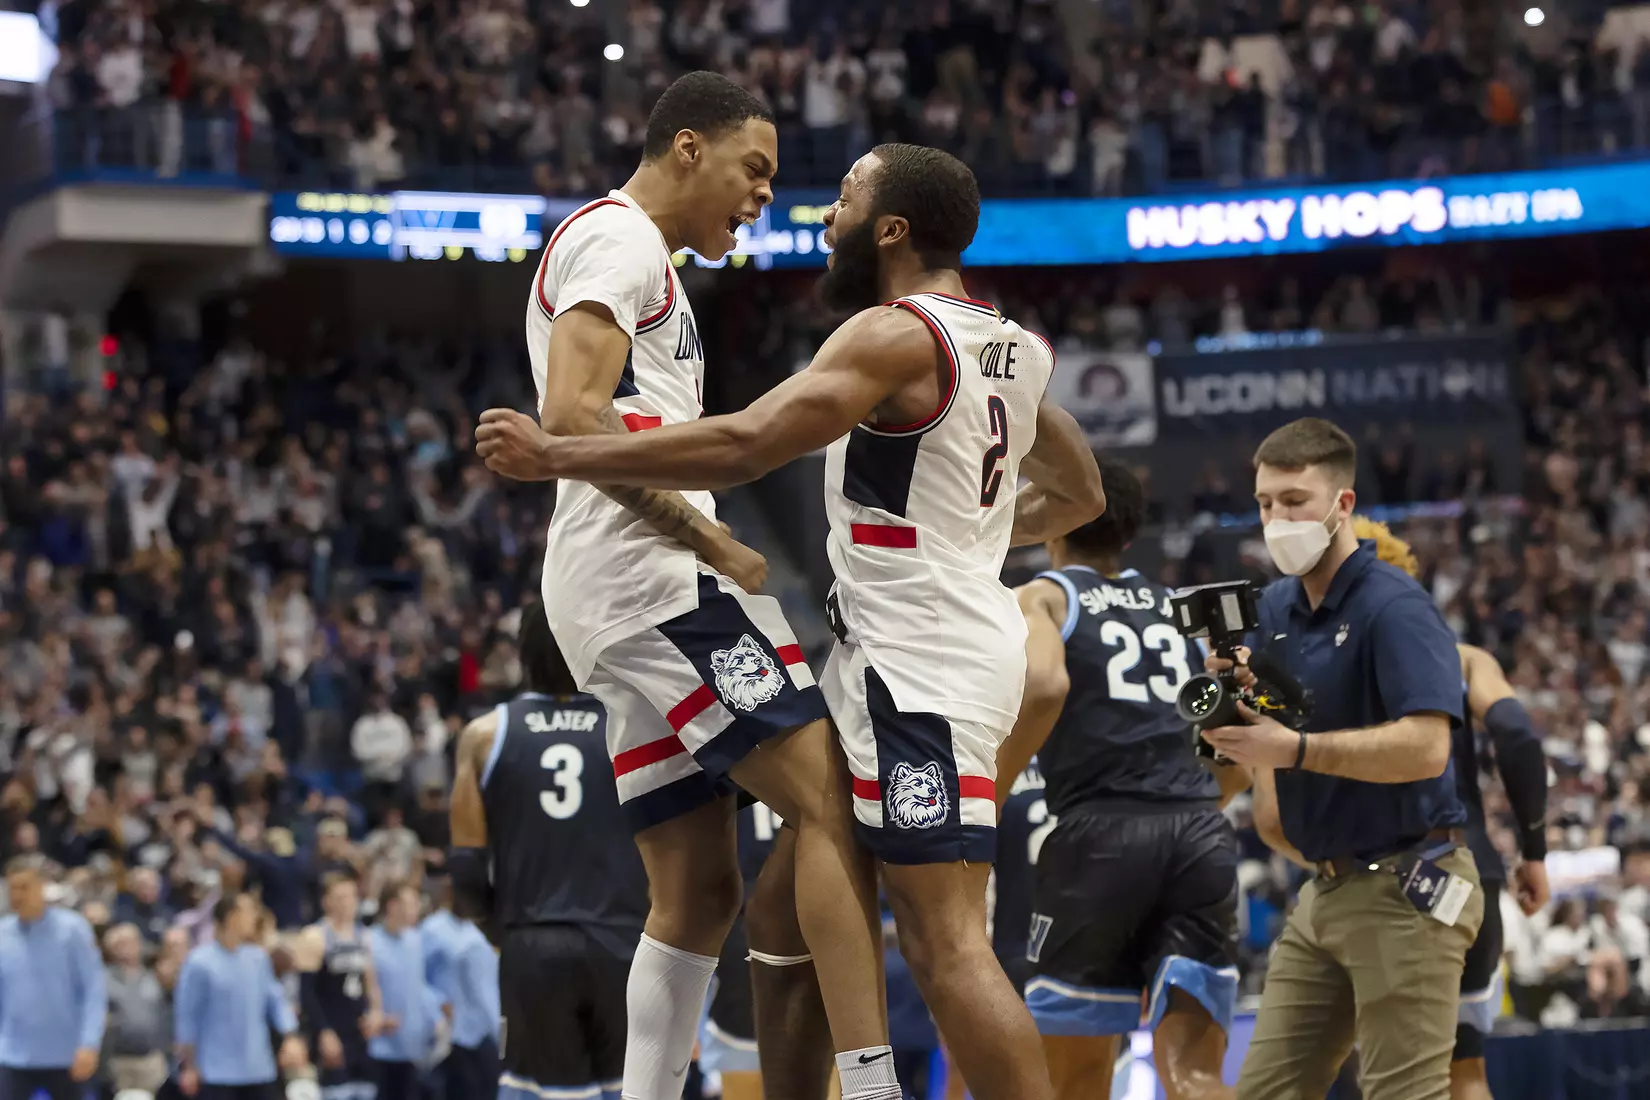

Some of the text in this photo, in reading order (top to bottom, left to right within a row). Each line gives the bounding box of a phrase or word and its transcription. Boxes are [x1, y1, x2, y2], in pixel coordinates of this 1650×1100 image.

[1126, 198, 1295, 249] HUSKY
[1300, 186, 1447, 239] HOPS
[979, 341, 1017, 380] COLE
[1162, 367, 1326, 416] UCONN
[980, 395, 1009, 507] 2
[1100, 620, 1191, 703] 23
[524, 709, 599, 733] SLATER
[540, 743, 584, 820] 3
